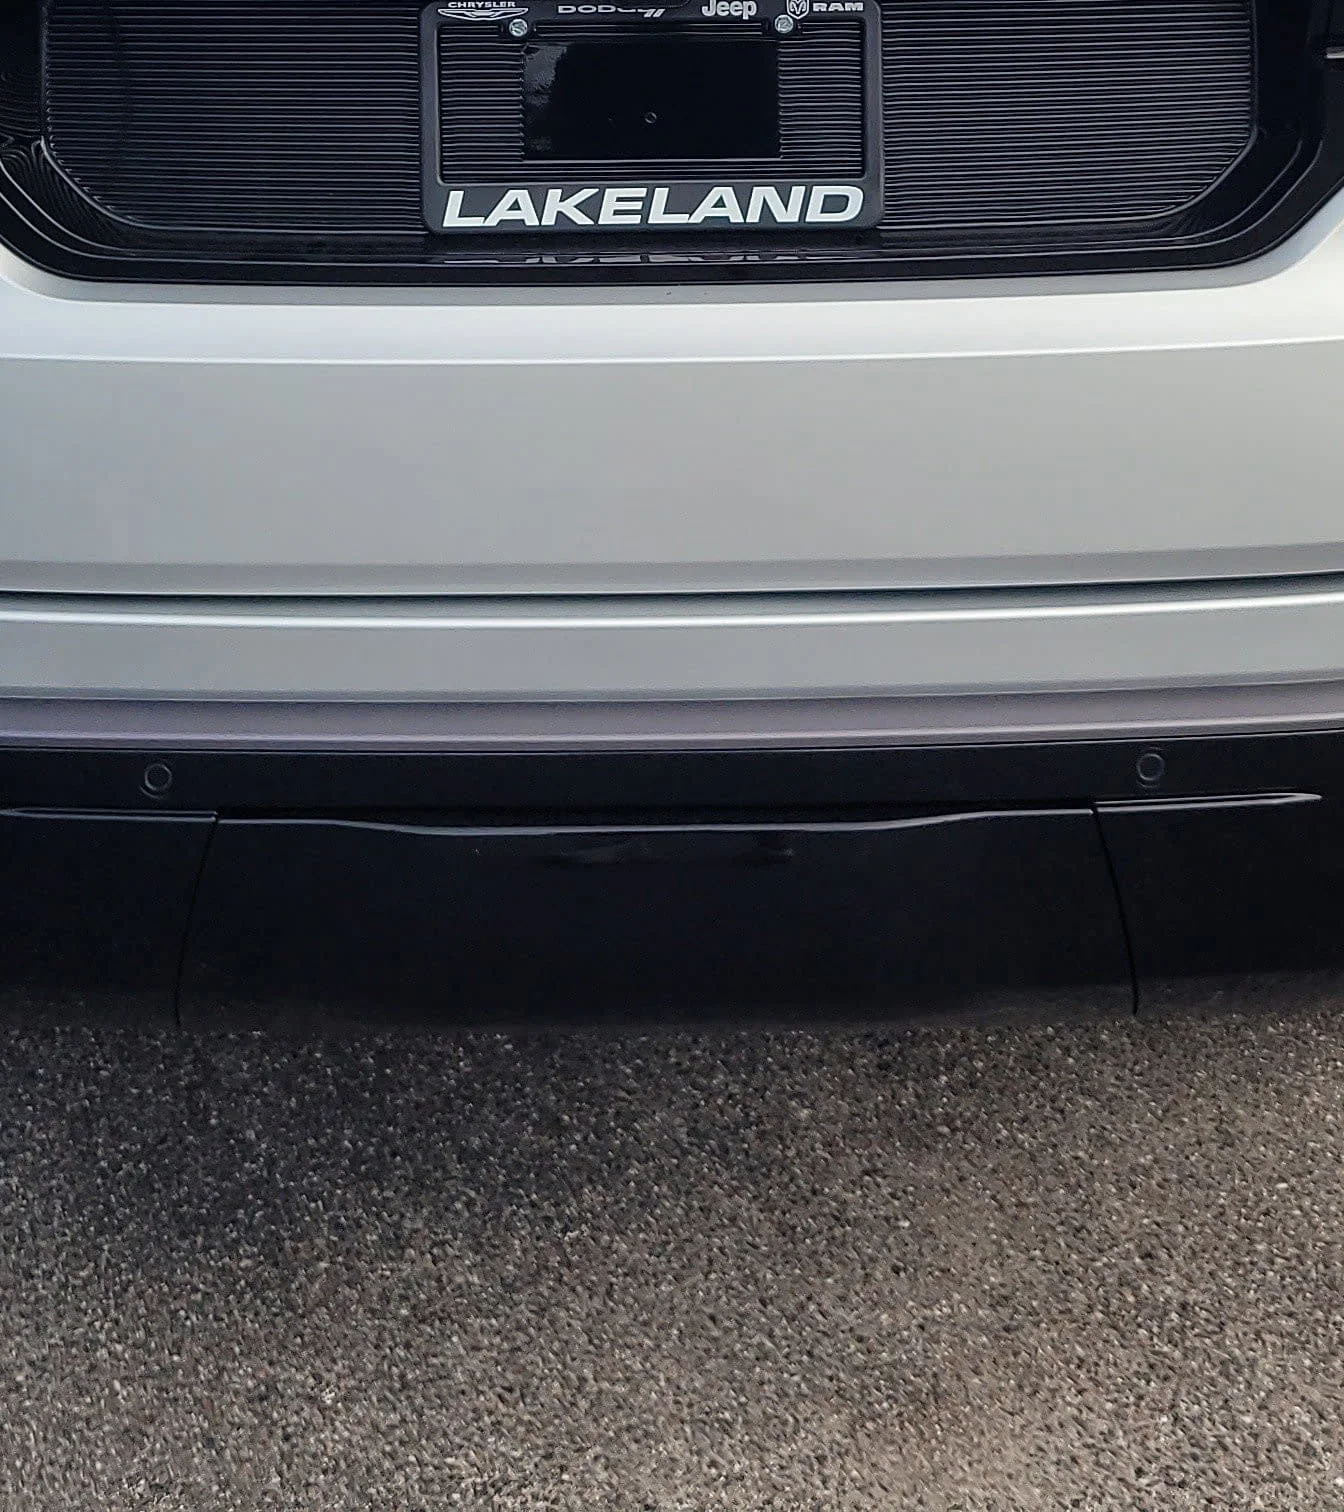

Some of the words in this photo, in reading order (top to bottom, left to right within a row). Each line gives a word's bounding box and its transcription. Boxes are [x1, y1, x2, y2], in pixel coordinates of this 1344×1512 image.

[558, 4, 648, 14] DOD
[812, 2, 864, 12] RAM
[442, 185, 865, 227] LAKELAND
